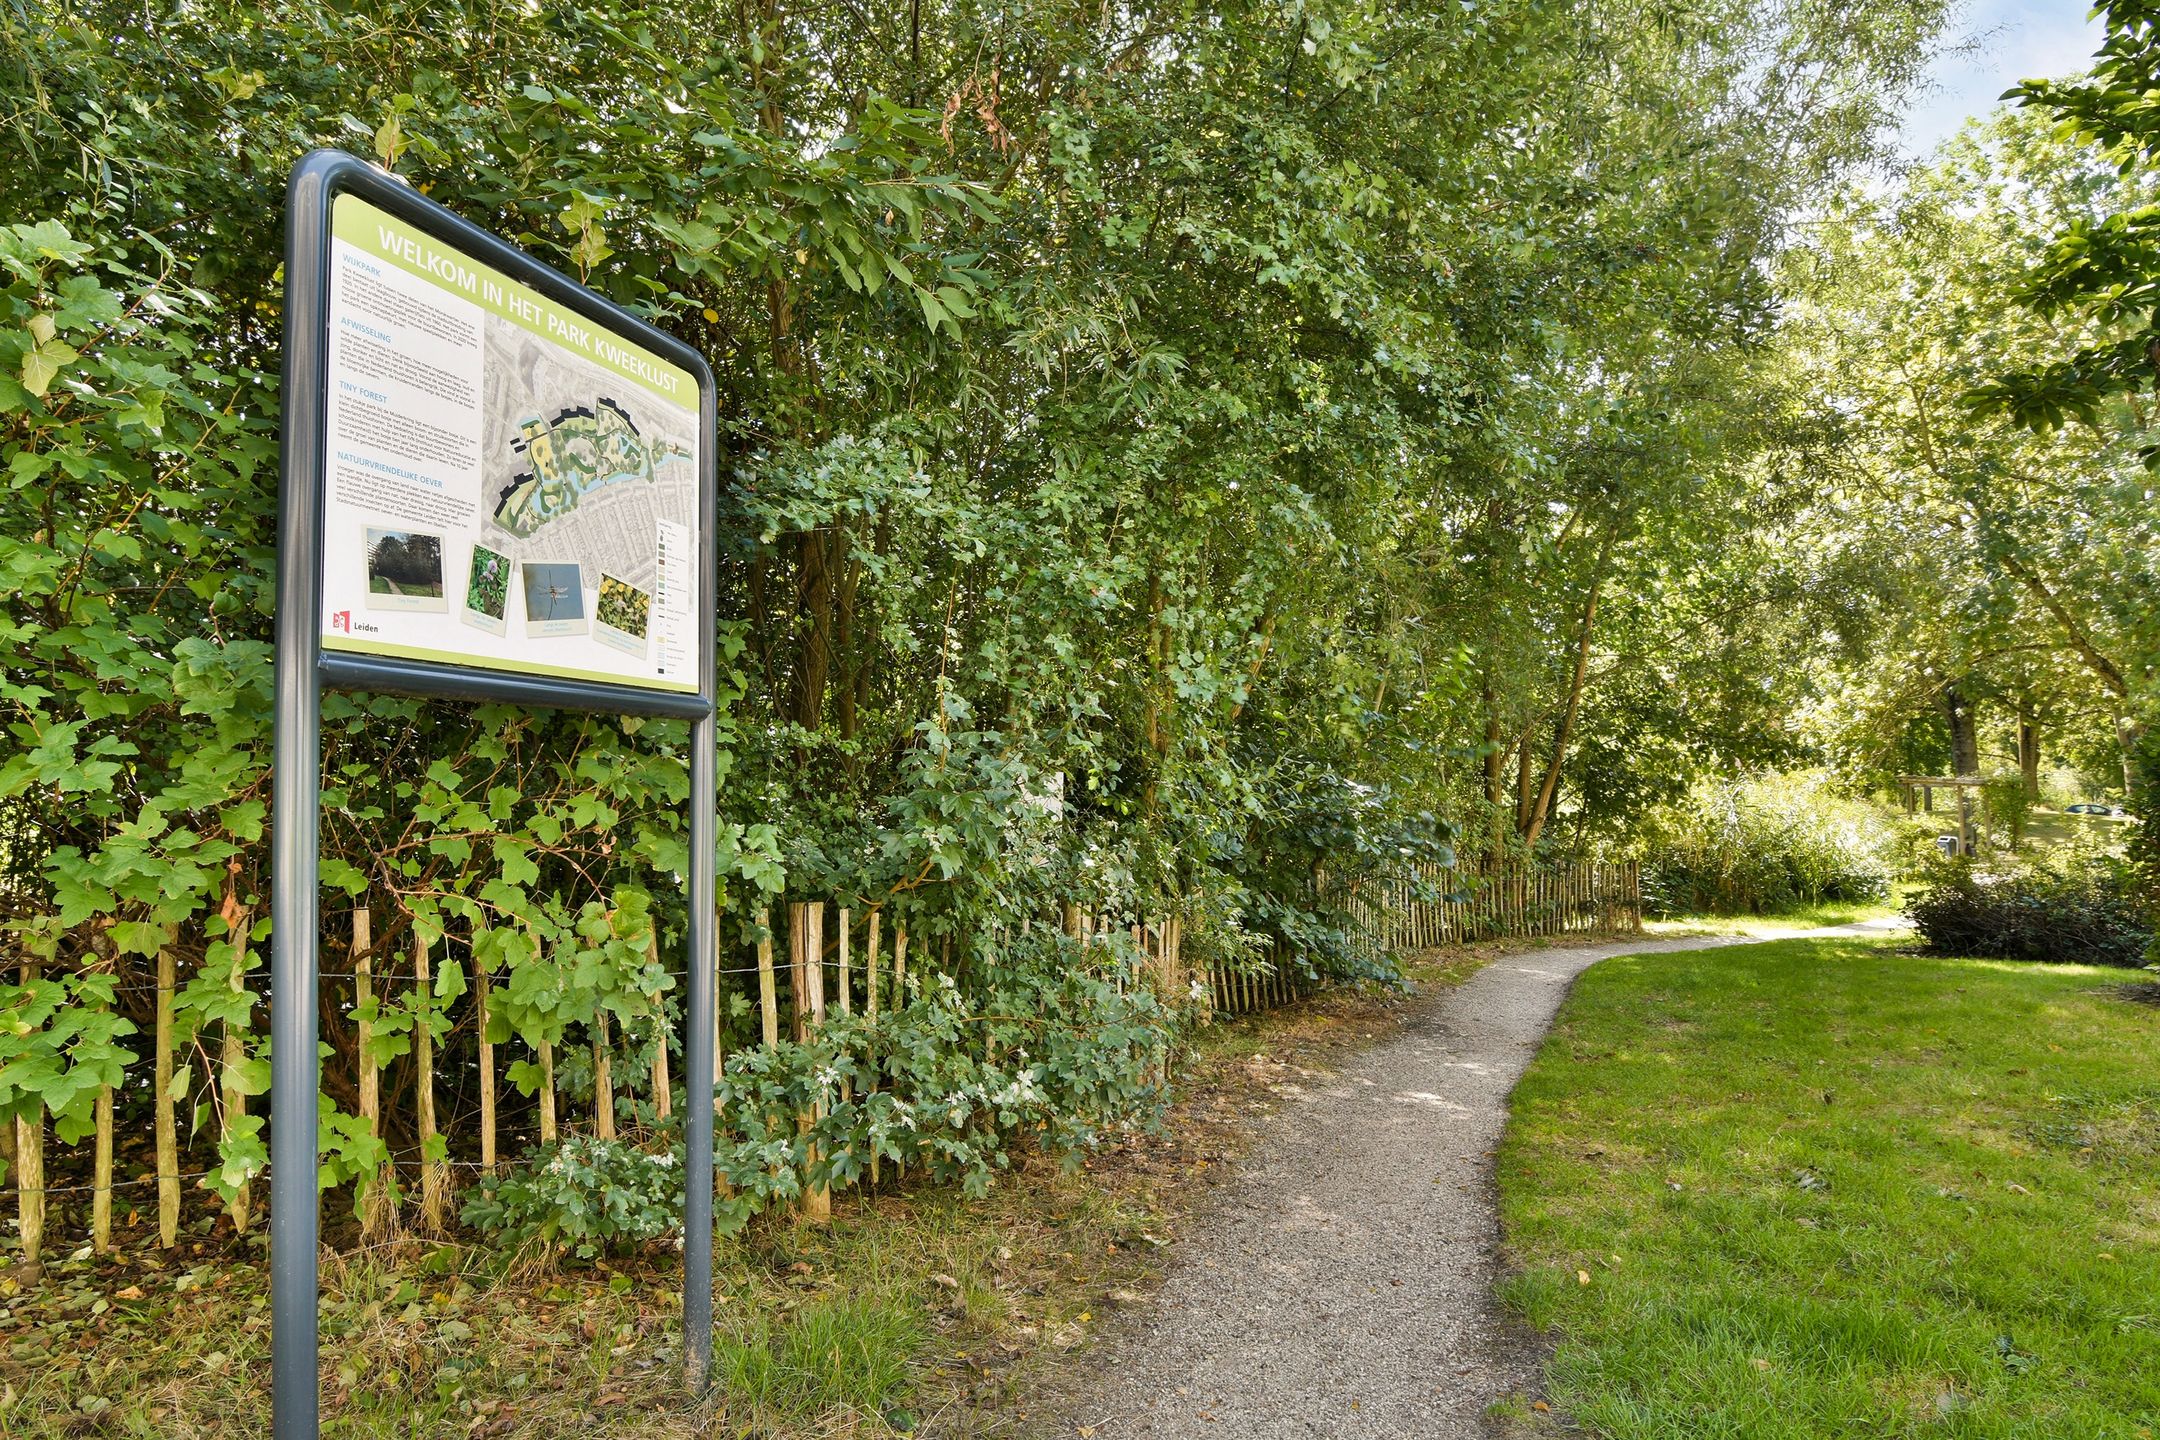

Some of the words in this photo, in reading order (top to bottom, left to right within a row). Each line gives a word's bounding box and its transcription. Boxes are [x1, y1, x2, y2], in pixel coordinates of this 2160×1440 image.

[342, 252, 381, 277] WIJKPARK
[378, 224, 477, 294] WELKOM
[483, 279, 502, 306] IN
[509, 293, 543, 326] HET
[548, 312, 591, 351] PARK
[594, 336, 678, 394] KWEEKLUST
[341, 316, 391, 343] AFWISSELING
[339, 380, 357, 393] TINY
[359, 387, 387, 404] FOREST
[337, 451, 418, 480] NATUURVRIENDELIJKE
[420, 475, 443, 488] OEVER
[354, 622, 379, 633] Leiden
